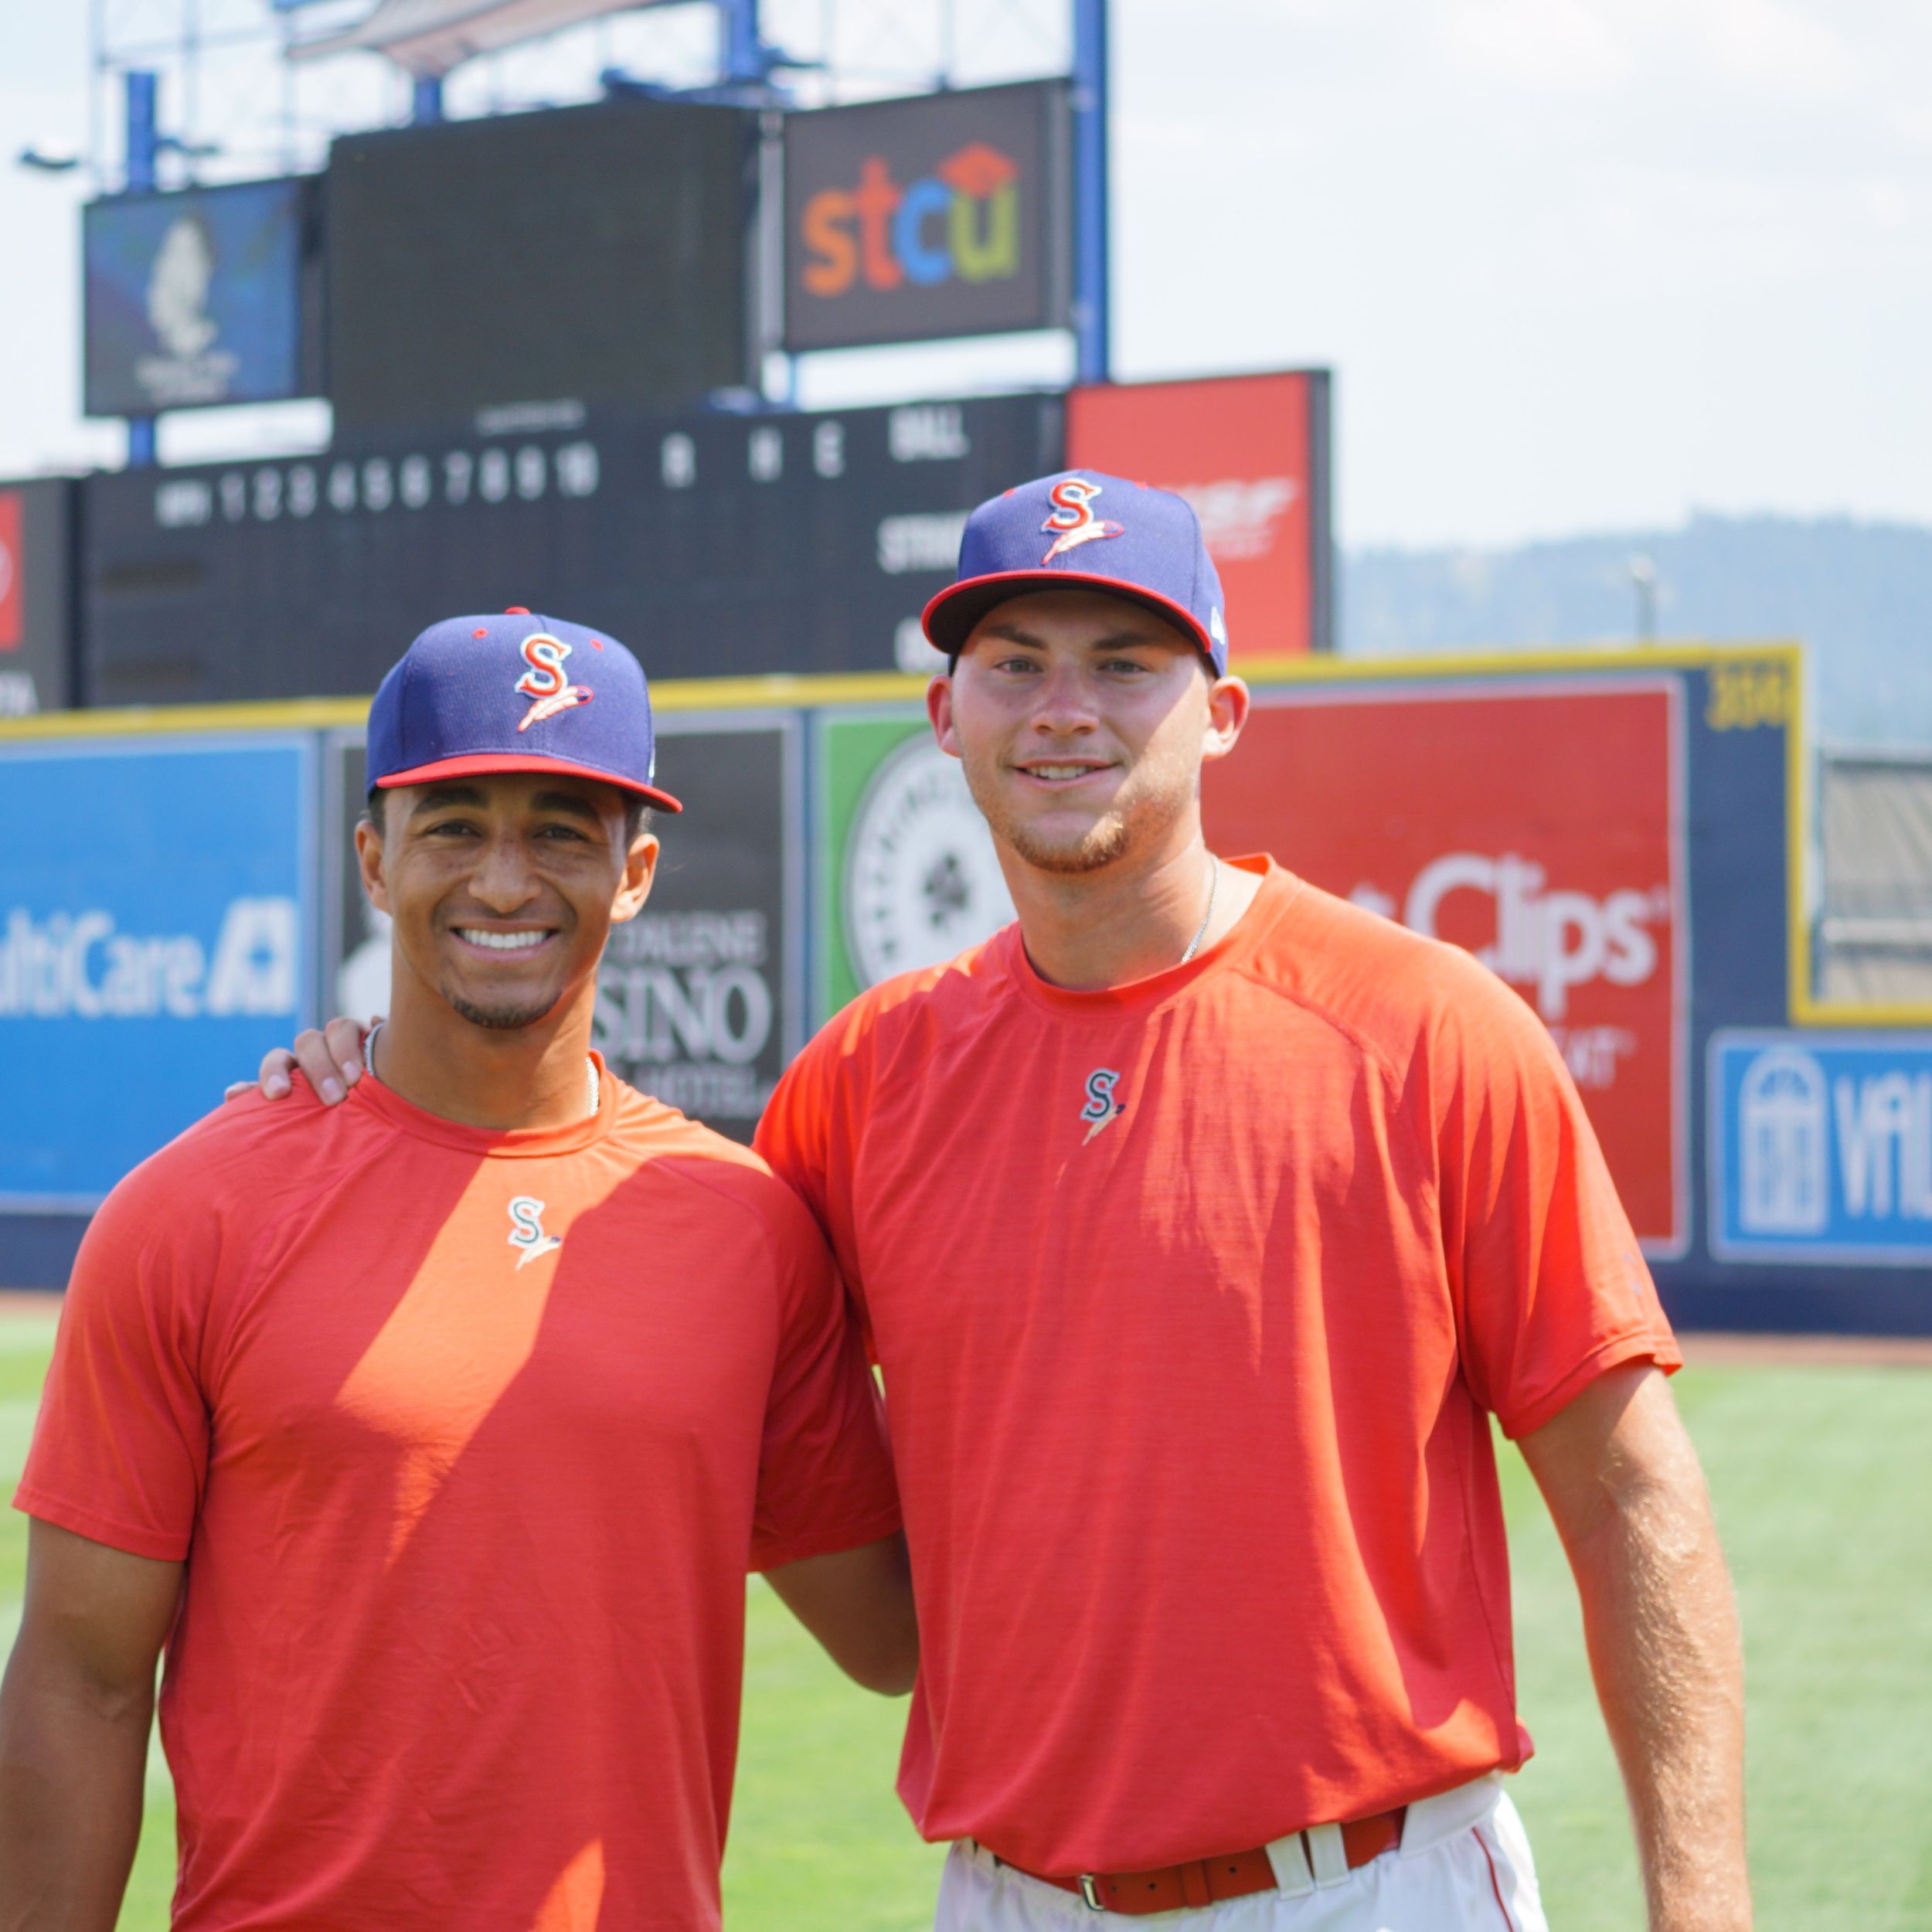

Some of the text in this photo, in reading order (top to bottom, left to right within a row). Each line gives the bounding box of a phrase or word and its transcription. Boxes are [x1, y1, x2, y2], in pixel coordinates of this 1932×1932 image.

[801, 156, 1019, 297] stcu
[221, 472, 245, 522] 1
[253, 467, 282, 521] 2
[444, 451, 472, 505] 7
[1041, 478, 1102, 533] S
[514, 633, 573, 699] S
[1404, 851, 1658, 1021] Clips
[1080, 1068, 1121, 1122] S
[507, 1196, 546, 1250] S
